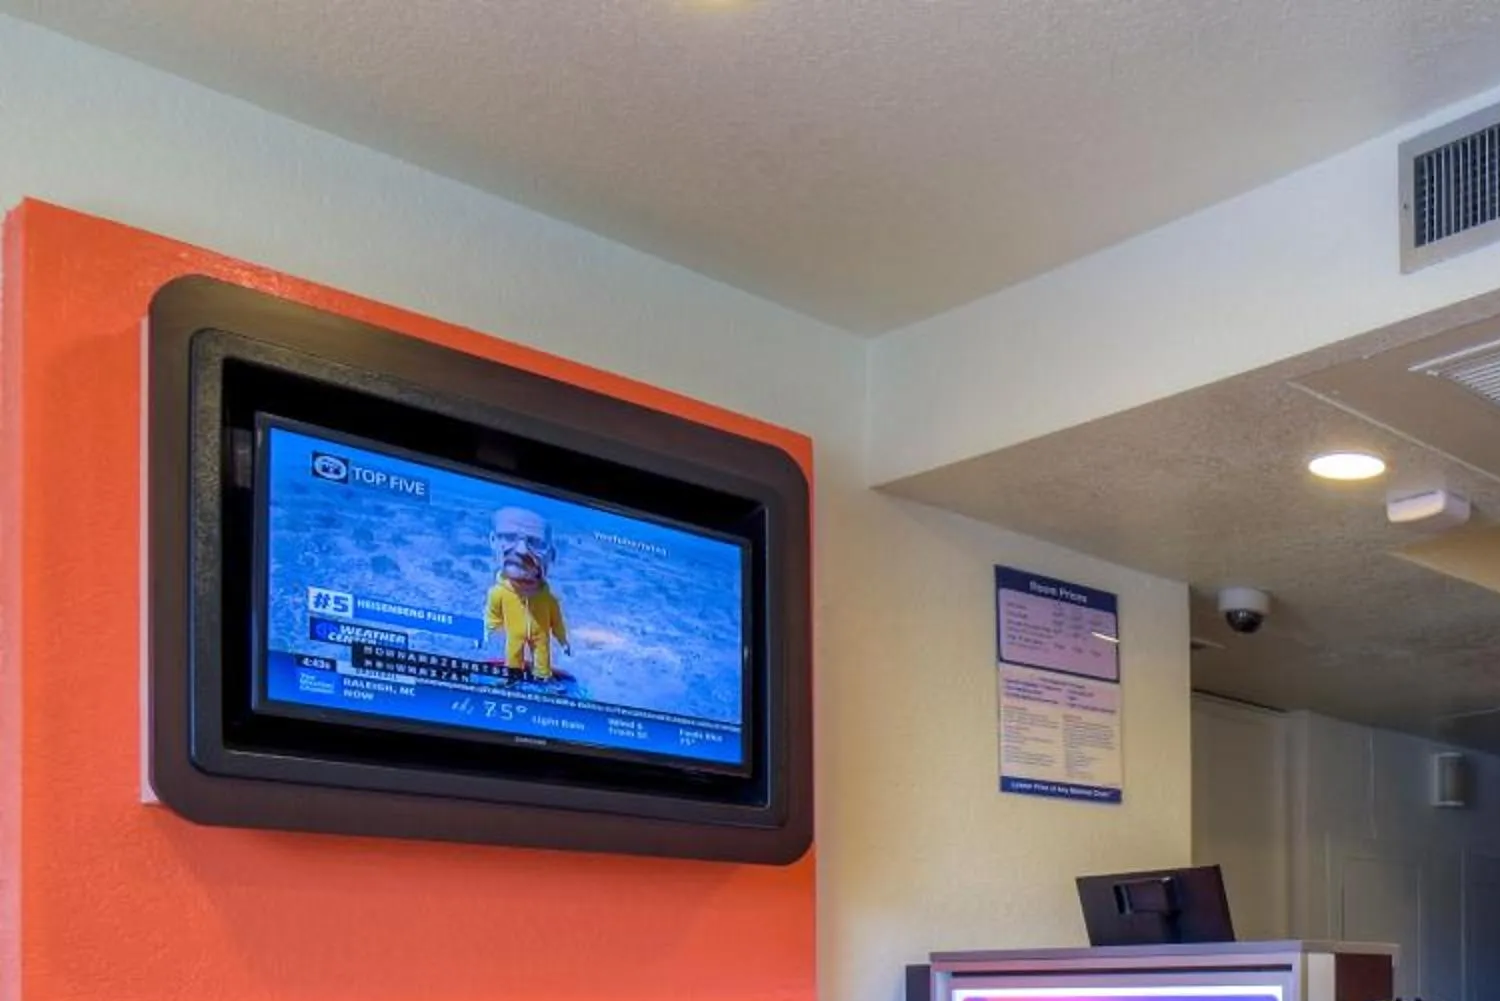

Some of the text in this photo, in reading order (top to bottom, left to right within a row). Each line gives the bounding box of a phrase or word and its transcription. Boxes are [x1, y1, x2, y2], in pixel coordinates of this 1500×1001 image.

[352, 466, 425, 496] TOP FIVE
[314, 592, 349, 612] #5
[340, 624, 407, 643] WEATHER
[343, 689, 375, 700] NOW
